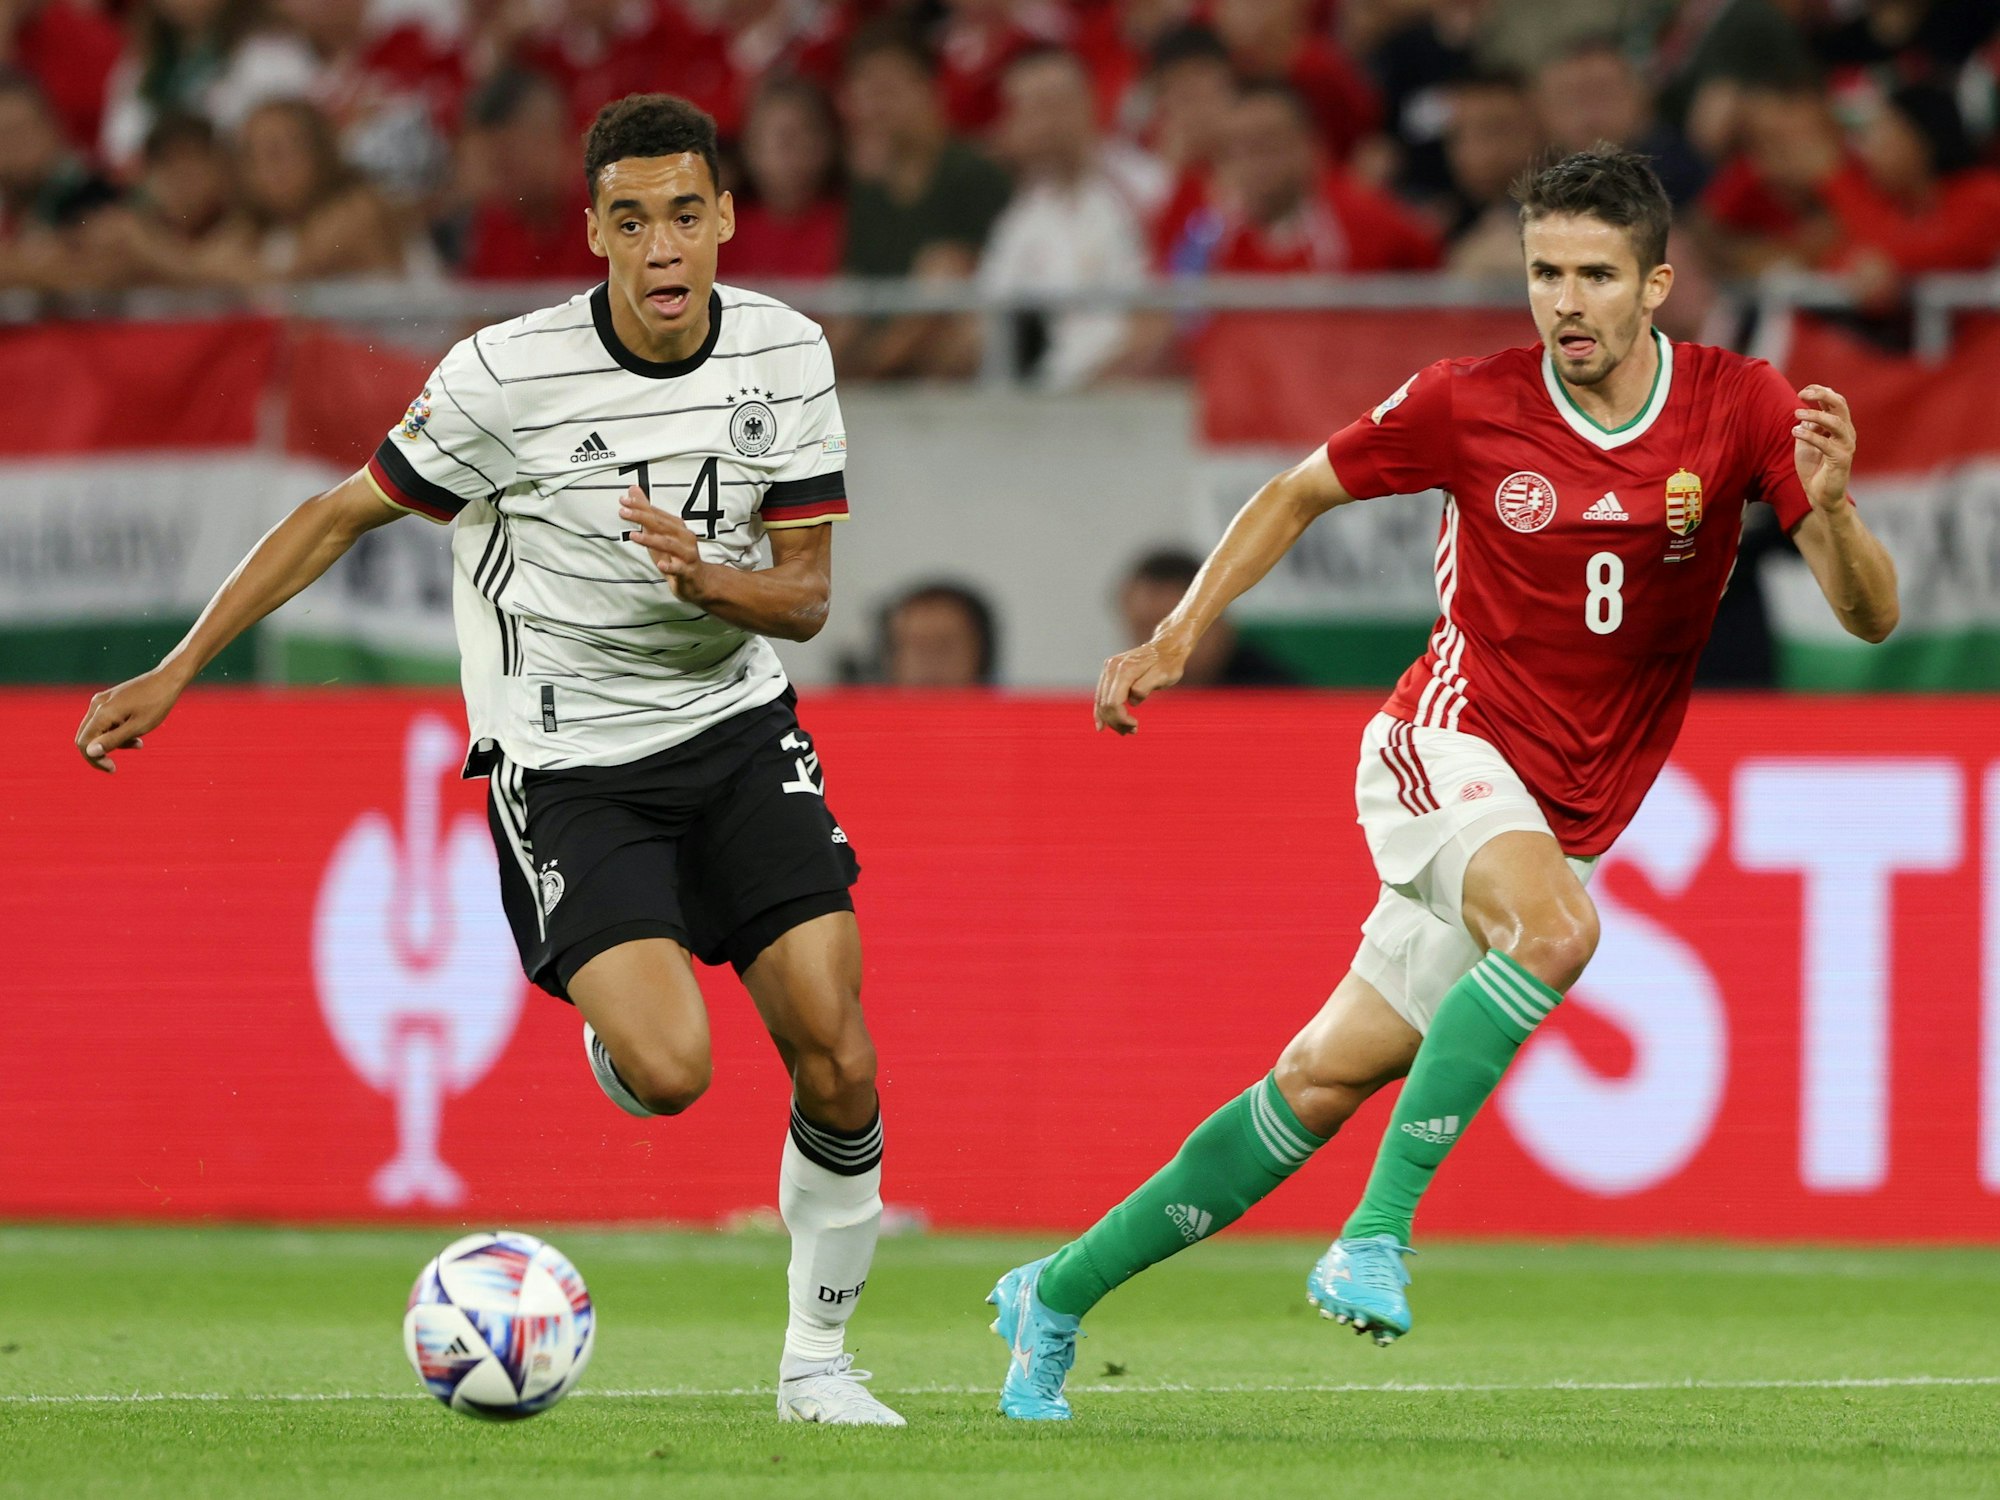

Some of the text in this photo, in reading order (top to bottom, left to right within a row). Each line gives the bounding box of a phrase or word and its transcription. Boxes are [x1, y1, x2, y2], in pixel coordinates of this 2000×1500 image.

[570, 450, 617, 463] adidas
[618, 456, 725, 543] 14
[1582, 510, 1629, 522] adidas
[1584, 551, 1625, 635] 8
[1400, 1122, 1457, 1145] adidas
[1164, 1203, 1197, 1243] adida
